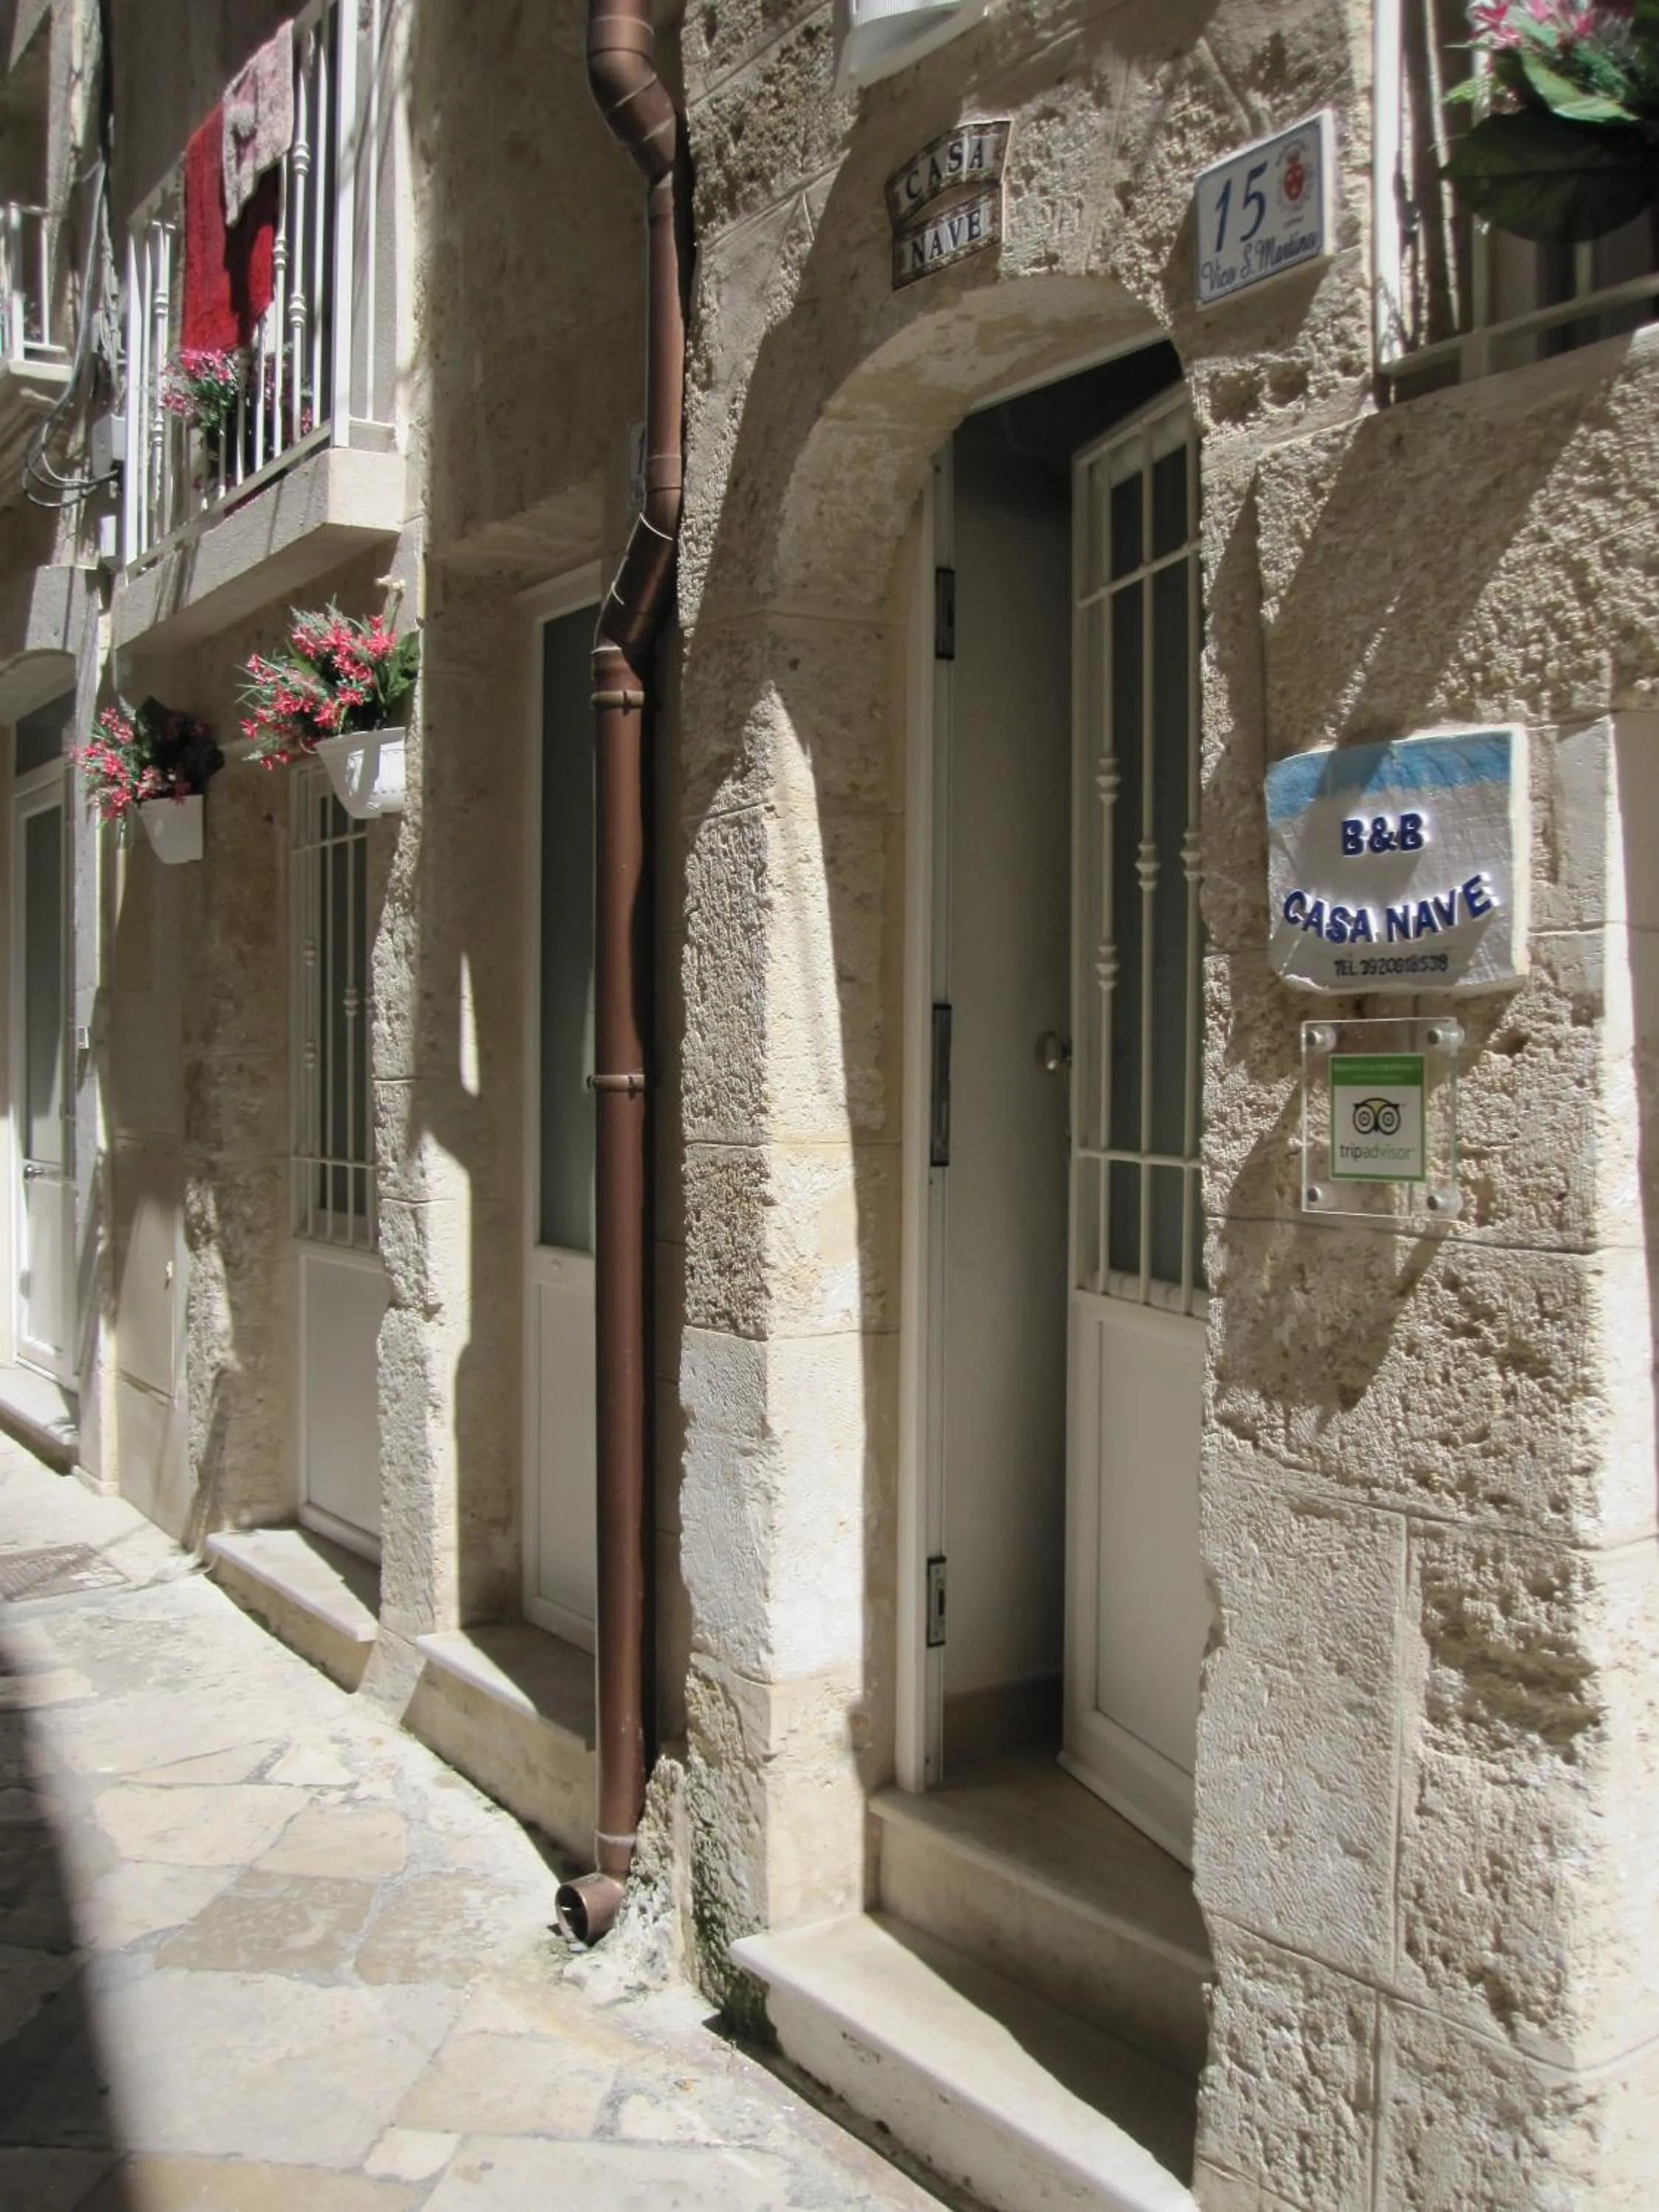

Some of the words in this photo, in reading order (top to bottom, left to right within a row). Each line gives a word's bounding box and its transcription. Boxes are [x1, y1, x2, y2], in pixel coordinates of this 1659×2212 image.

[905, 138, 984, 200] CASA
[1214, 161, 1268, 253] 15
[911, 209, 981, 268] NAVE
[1201, 256, 1237, 291] Vico
[1254, 230, 1318, 271] Martino
[1341, 813, 1424, 856] B&B
[1283, 890, 1375, 945] CASA
[1386, 874, 1494, 943] NAVE
[1339, 1144, 1413, 1161] tripadvisor
